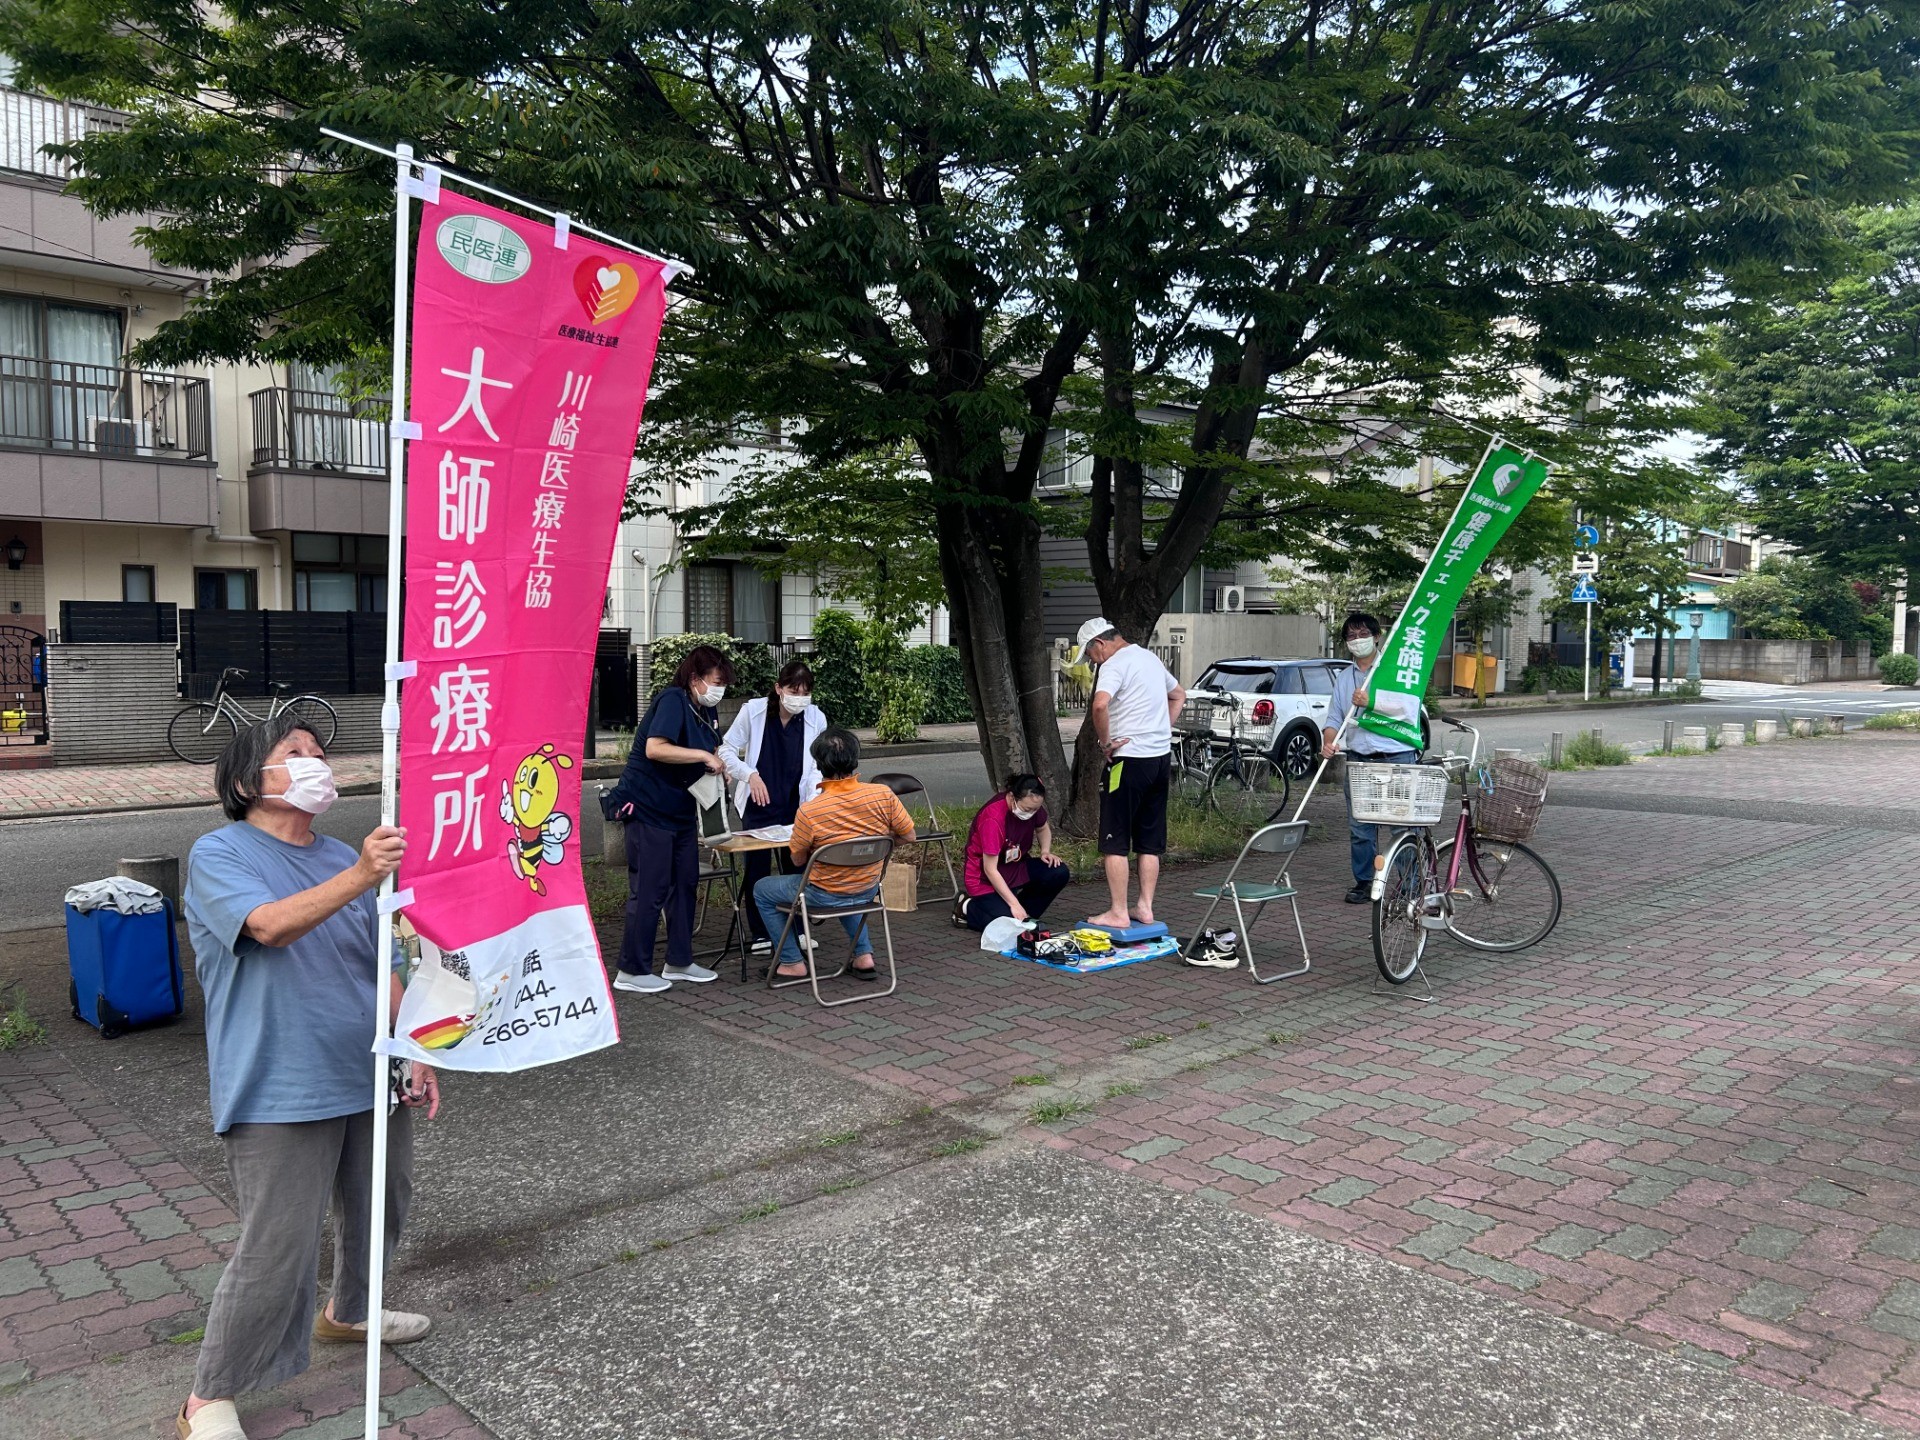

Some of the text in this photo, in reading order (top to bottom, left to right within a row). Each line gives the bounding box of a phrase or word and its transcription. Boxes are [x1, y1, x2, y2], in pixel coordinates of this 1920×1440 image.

[449, 230, 519, 268] 民医連
[525, 371, 592, 608] 川崎医療生協
[428, 346, 514, 862] 大師診療所
[1395, 510, 1493, 690] 健康チェック実施中
[483, 996, 598, 1046] 266-5744
